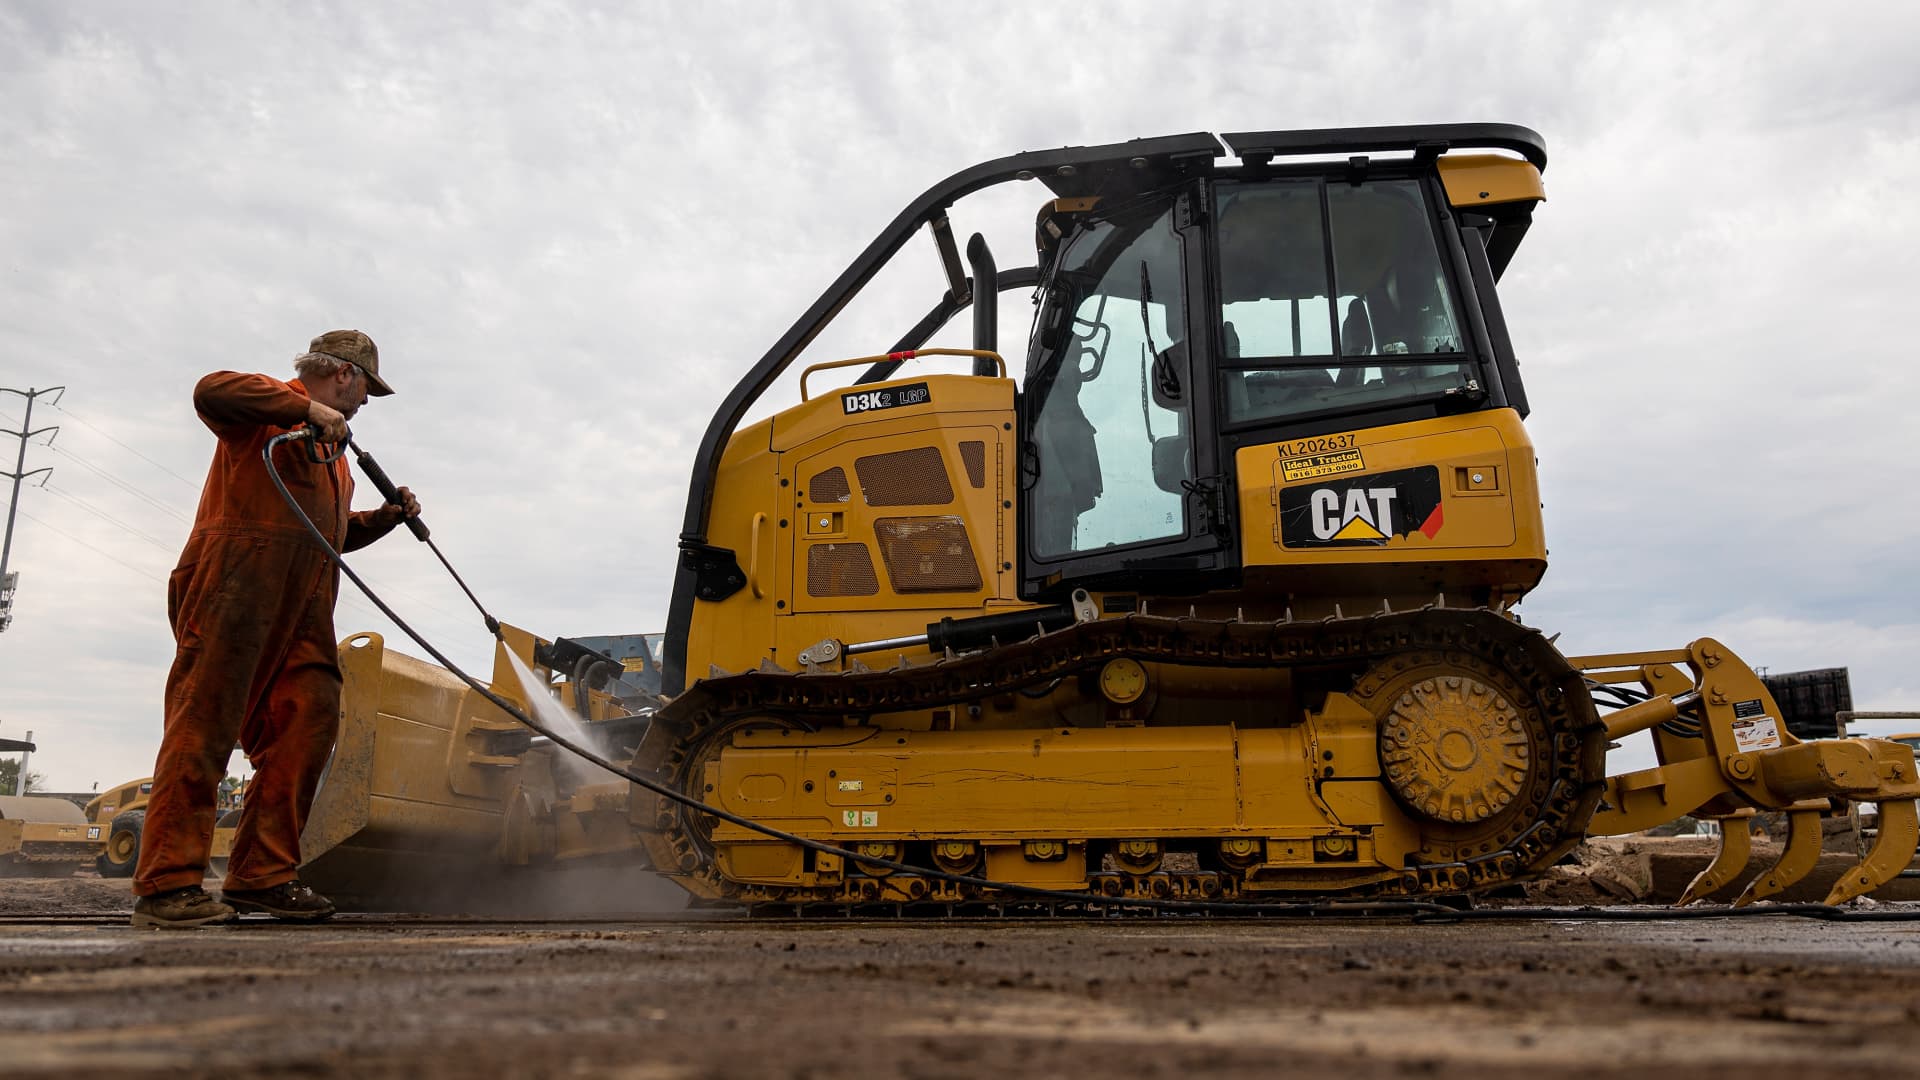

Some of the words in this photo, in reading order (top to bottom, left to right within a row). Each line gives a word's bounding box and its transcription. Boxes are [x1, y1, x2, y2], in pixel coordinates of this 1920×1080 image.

[900, 389, 927, 404] LGP
[1278, 435, 1355, 457] KL202637
[1286, 459, 1313, 470] Ideal
[1318, 453, 1358, 465] Tractor
[1316, 463, 1358, 475] 373-0900
[1311, 488, 1397, 540] CAT
